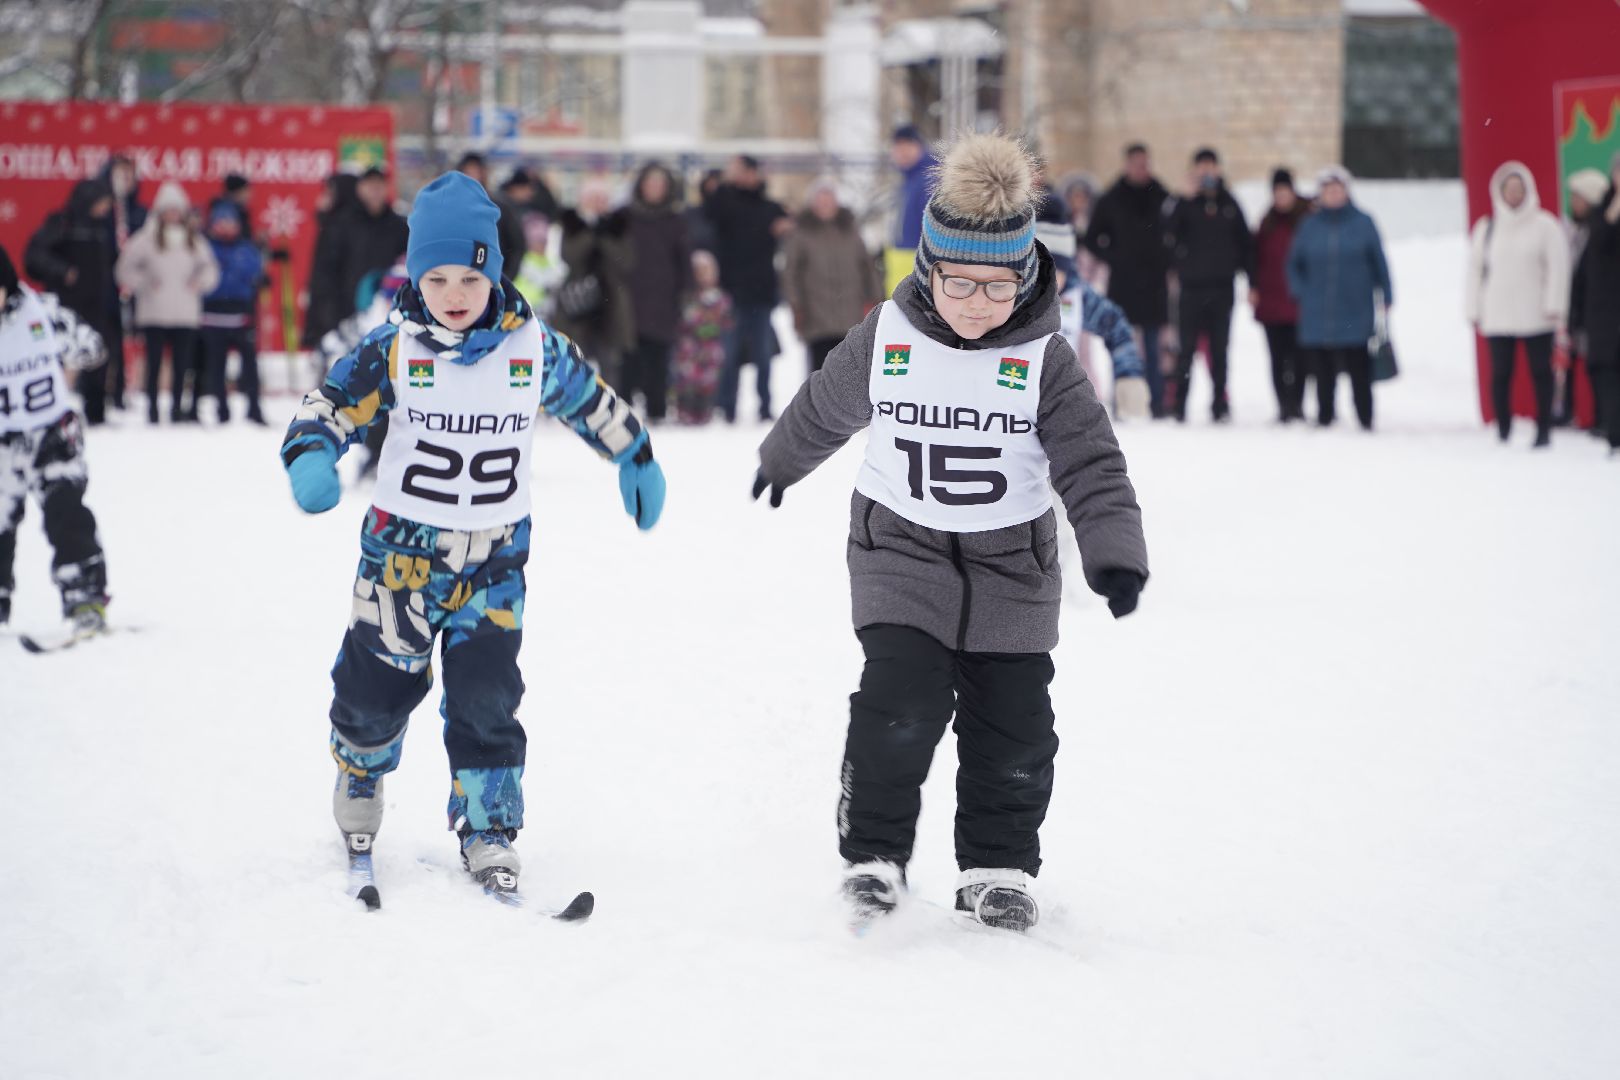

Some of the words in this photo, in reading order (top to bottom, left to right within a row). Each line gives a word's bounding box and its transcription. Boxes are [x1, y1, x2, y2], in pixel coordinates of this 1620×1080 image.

[208, 147, 335, 184] ЛЫЖНЯ
[407, 406, 530, 434] РОШАЛЬ
[876, 401, 1033, 434] РОШАЛЬ
[401, 439, 520, 506] 29
[894, 436, 1008, 506] 15
